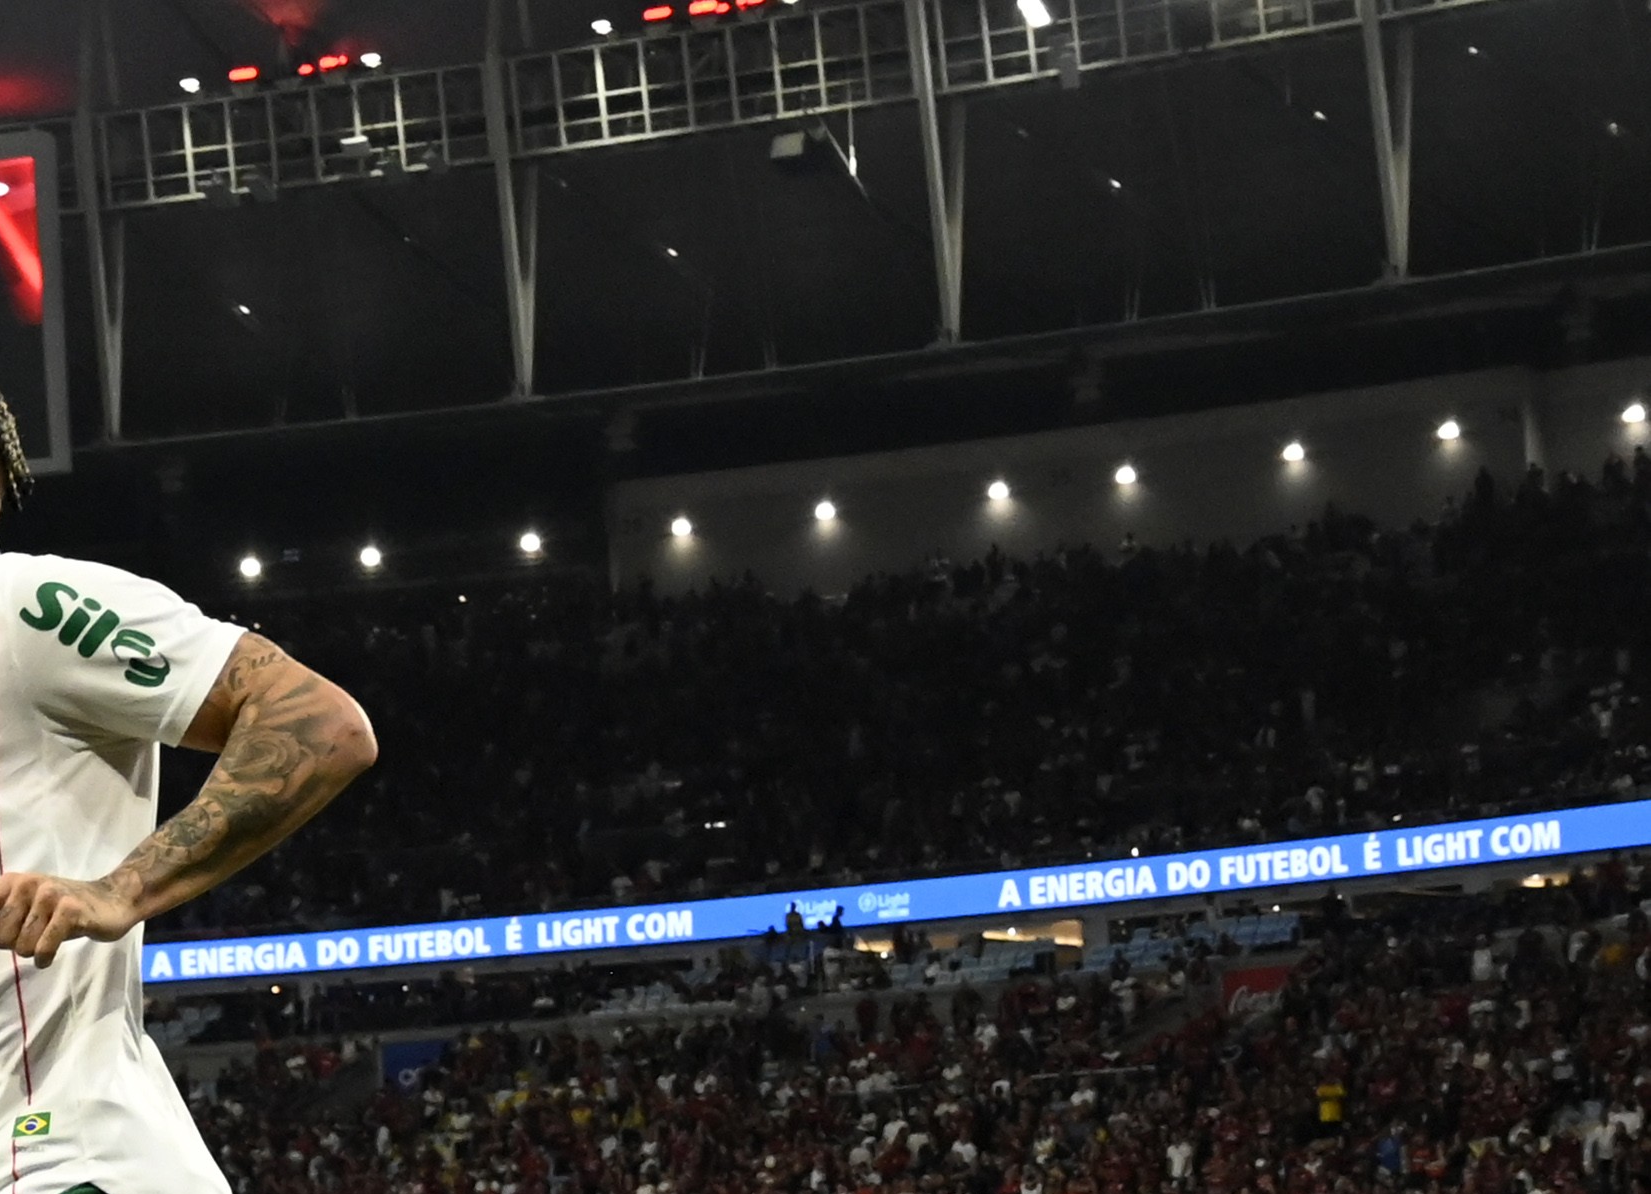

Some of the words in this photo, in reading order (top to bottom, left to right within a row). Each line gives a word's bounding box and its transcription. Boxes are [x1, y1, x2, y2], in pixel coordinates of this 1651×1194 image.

[998, 879, 1022, 908] A
[1029, 865, 1156, 906] ENERGIA
[1166, 859, 1210, 892] DO
[1219, 844, 1349, 886] FUTEBOL
[1364, 832, 1382, 871] É
[1397, 829, 1483, 867] LIGHT
[1490, 820, 1561, 857] COM
[151, 951, 173, 978] A
[180, 941, 307, 977] ENERGIA
[316, 937, 360, 967] DO
[368, 926, 491, 963] FUTEBOL
[505, 916, 522, 952] É
[537, 915, 619, 949] LIGHT
[625, 910, 693, 942] COM
